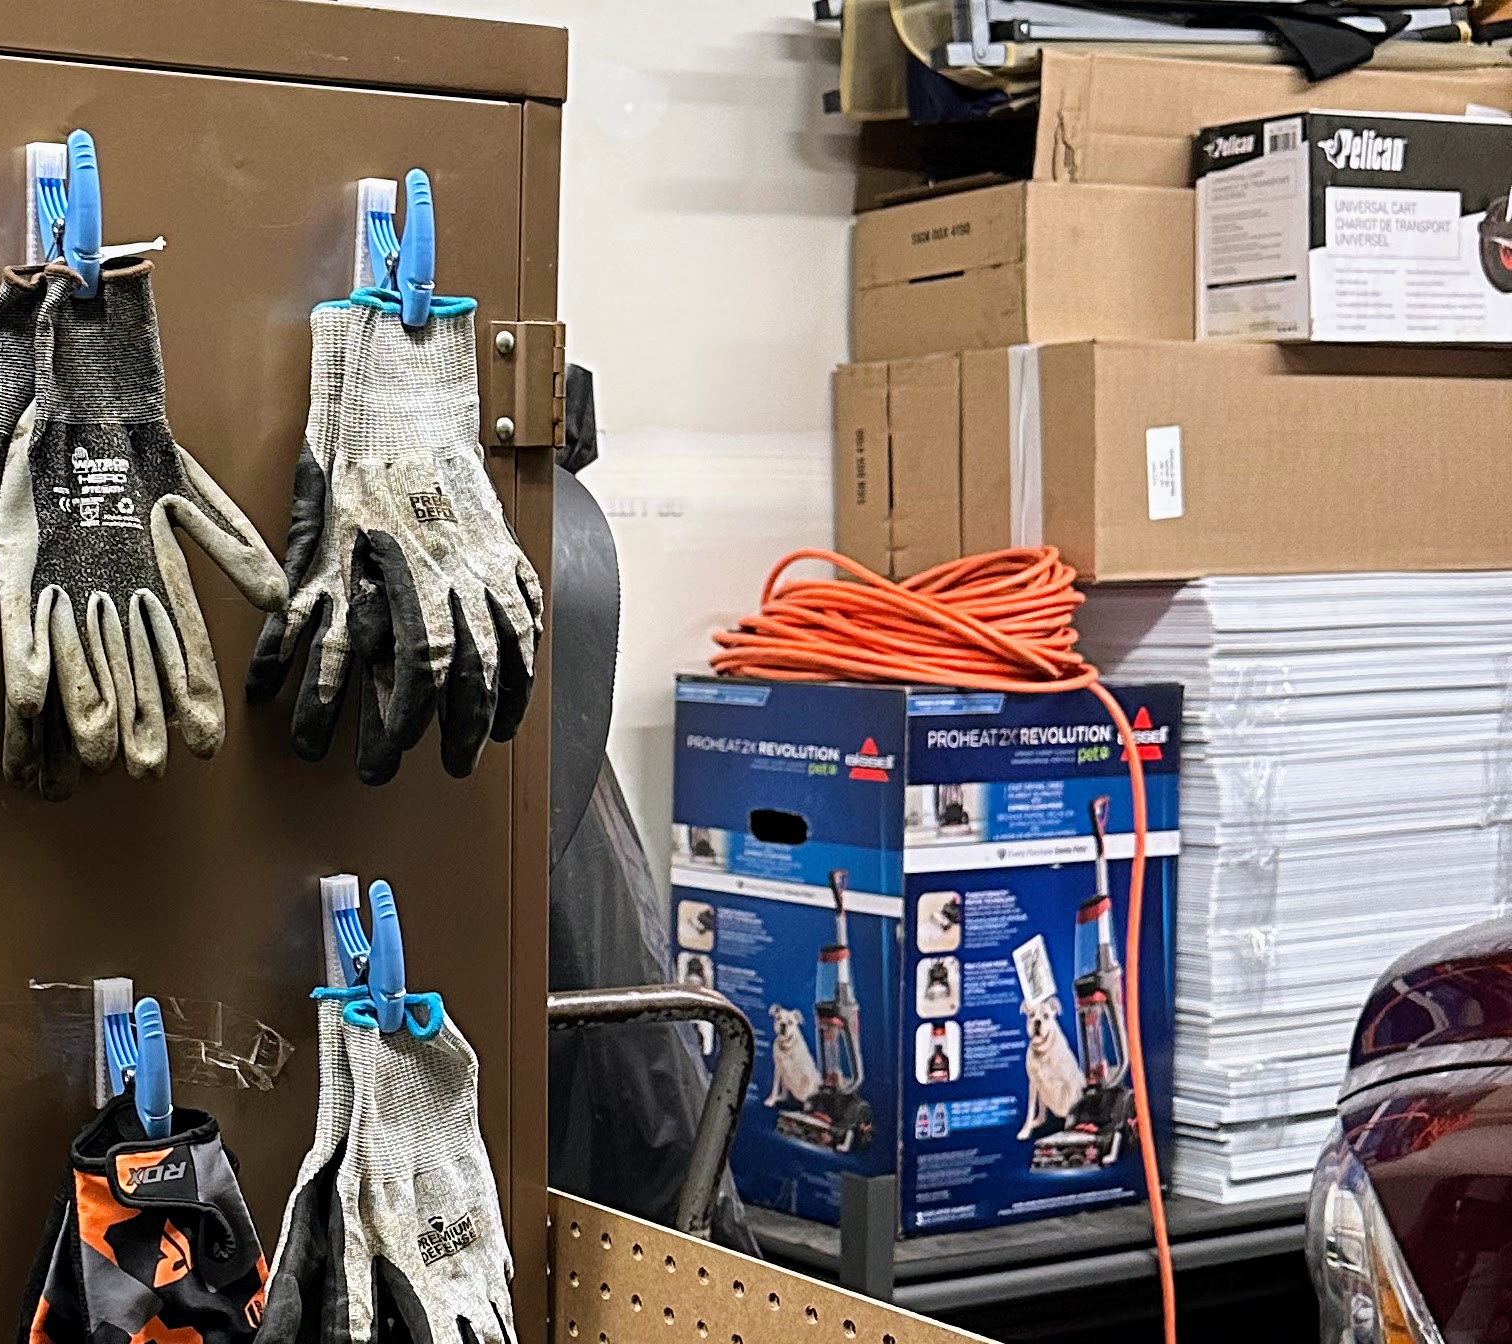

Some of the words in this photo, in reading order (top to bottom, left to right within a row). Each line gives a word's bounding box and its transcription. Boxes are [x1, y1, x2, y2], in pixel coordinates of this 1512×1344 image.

[1328, 128, 1404, 172] Pelican
[1334, 199, 1390, 215] UNIVERSAL
[1391, 201, 1418, 216] CART
[1334, 217, 1379, 233] CHARIOT
[1380, 218, 1392, 233] DE
[1394, 218, 1451, 234] TRANSPORT
[1334, 232, 1390, 248] UNIVERSEL
[1019, 724, 1112, 746] REVOLUTION
[758, 741, 840, 762] REVOLUTION
[126, 1161, 187, 1186] RDX
[418, 1216, 473, 1250] PREMIUM
[421, 1228, 477, 1264] DEFENSE
